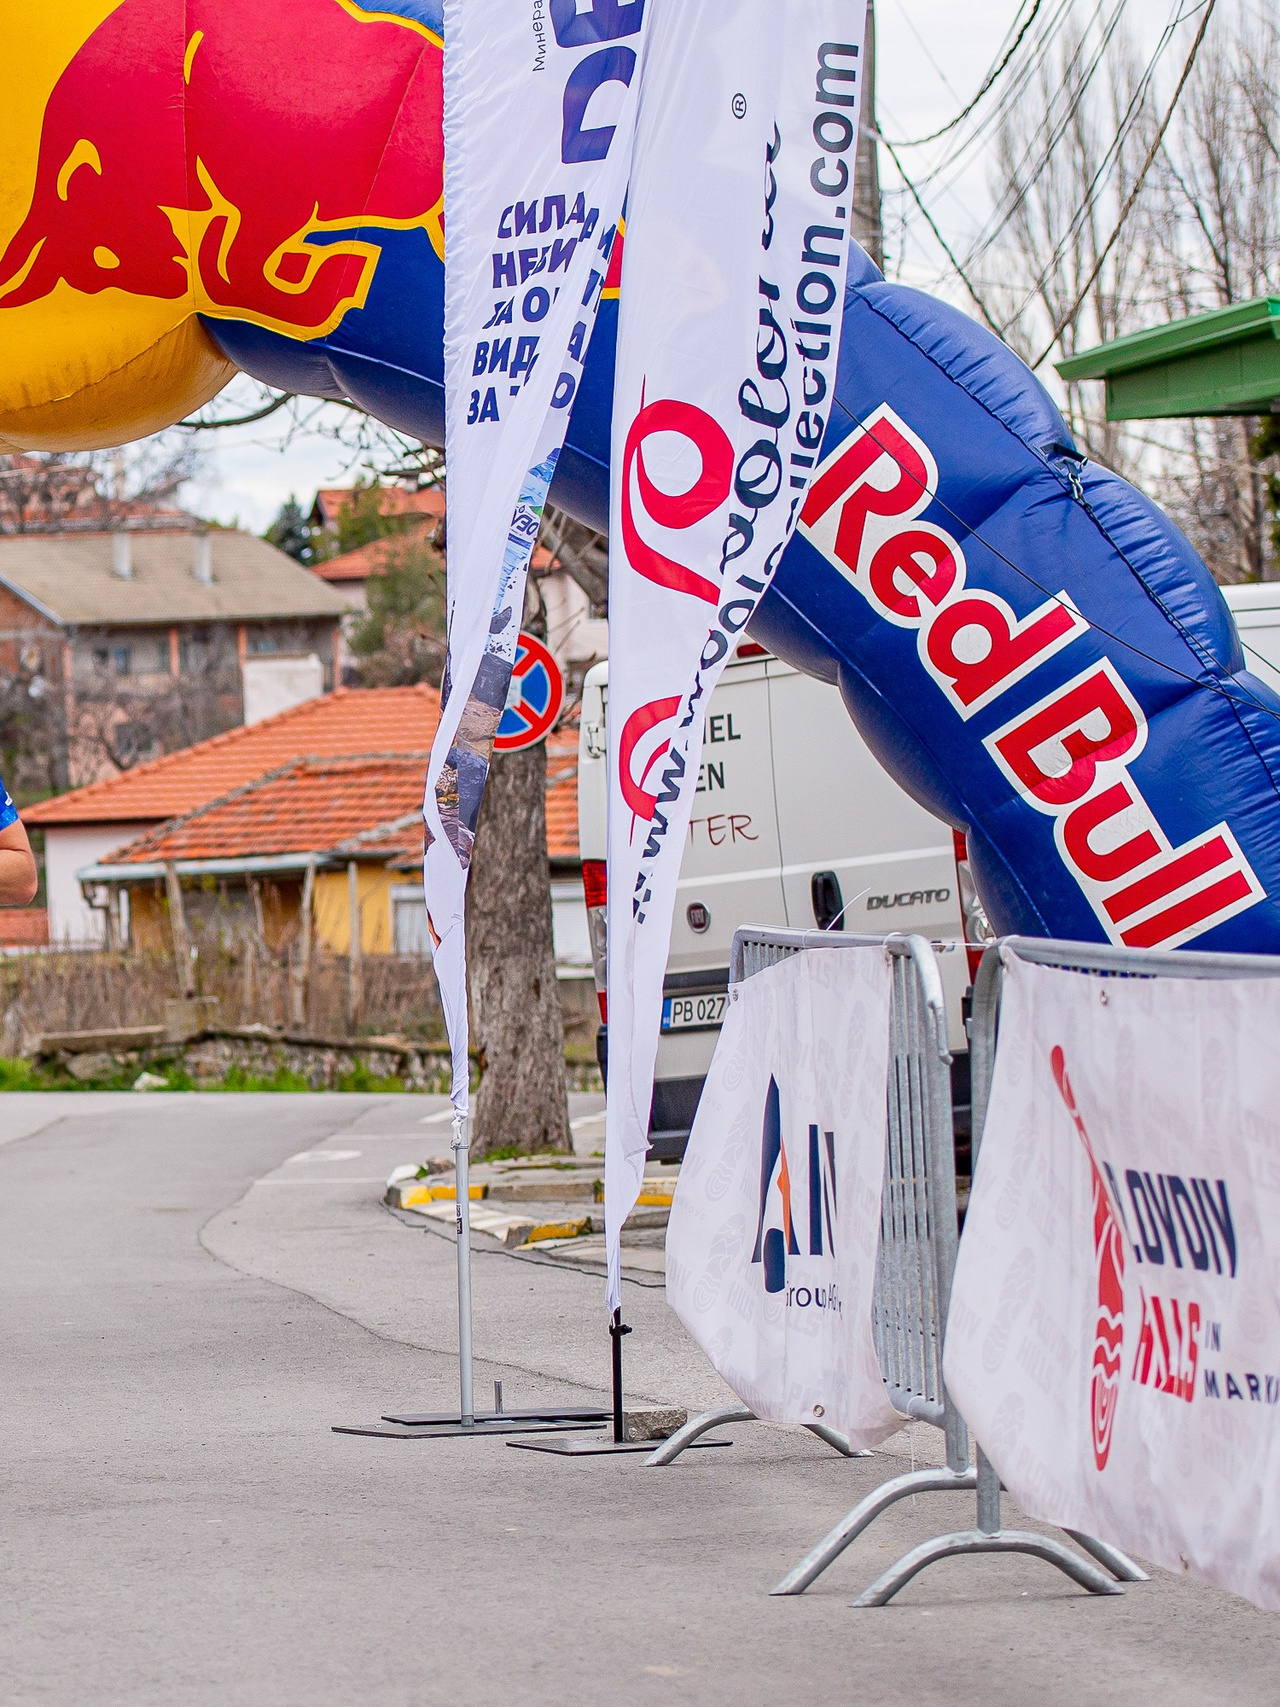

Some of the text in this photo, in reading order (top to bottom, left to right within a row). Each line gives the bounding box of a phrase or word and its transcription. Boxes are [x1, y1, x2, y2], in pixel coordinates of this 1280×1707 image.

[467, 386, 500, 425] ЗА
[801, 413, 1255, 948] Red Bull
[867, 888, 950, 911] DUCATO
[673, 996, 726, 1023] PB 027
